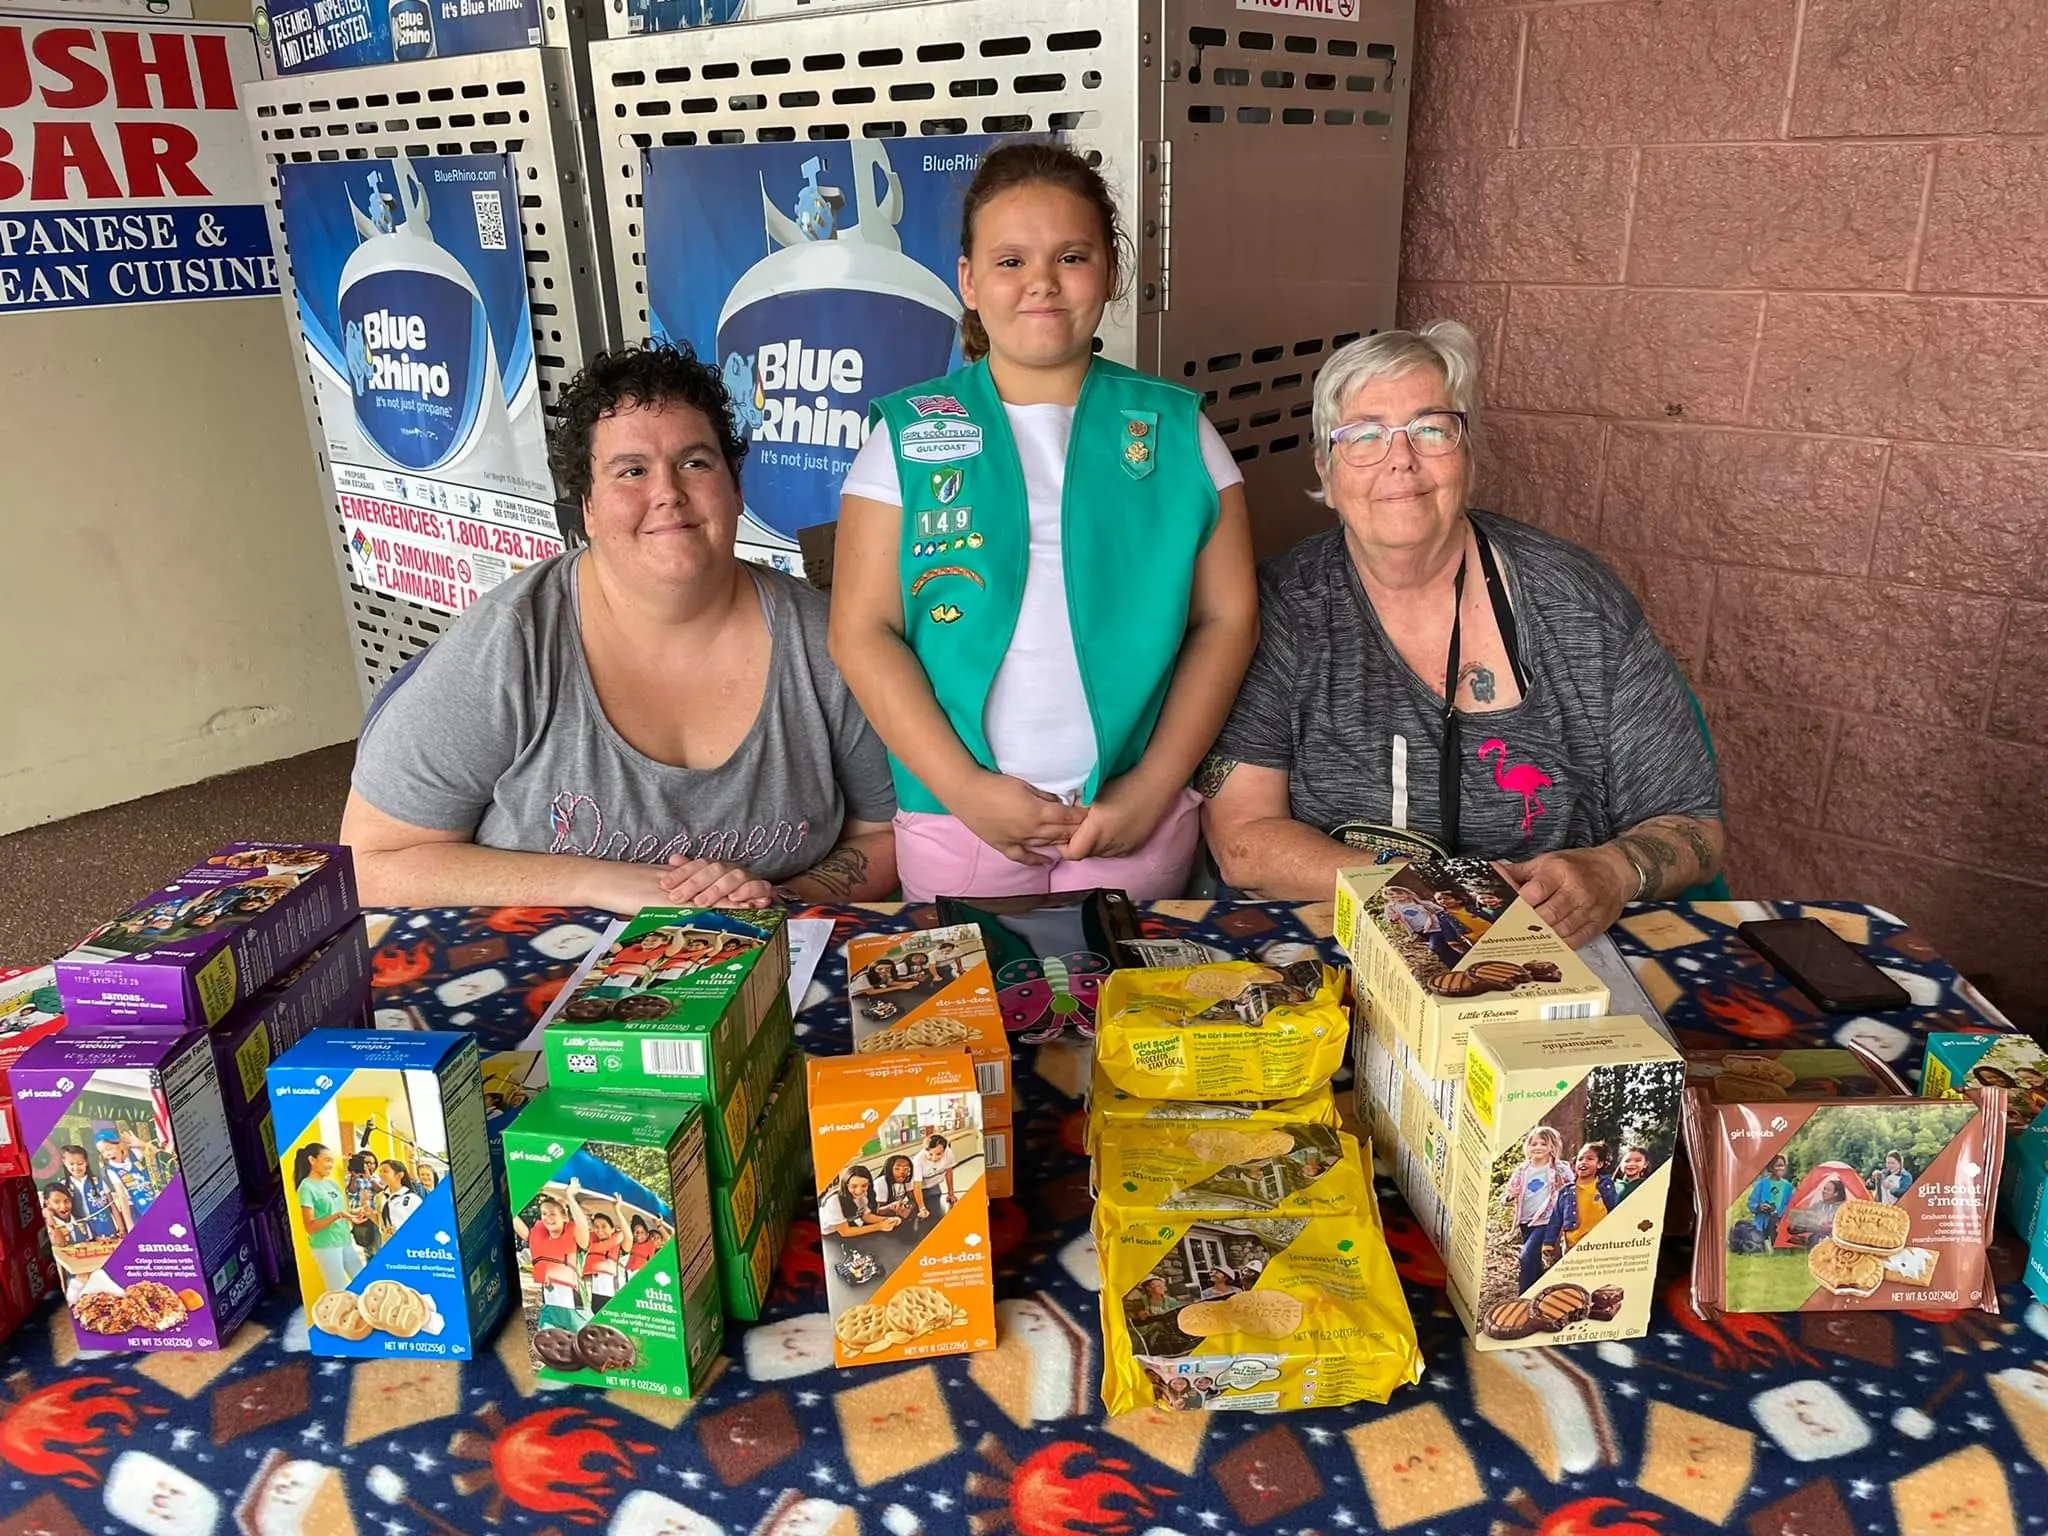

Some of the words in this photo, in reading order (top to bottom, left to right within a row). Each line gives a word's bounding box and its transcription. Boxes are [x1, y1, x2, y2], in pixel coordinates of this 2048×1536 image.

[442, 3, 458, 19] It's
[461, 0, 485, 15] Blue
[398, 12, 423, 28] Blue
[399, 28, 431, 46] Rhino
[281, 39, 301, 68] AND
[434, 168, 497, 184] BlueRhino.com
[195, 213, 227, 247] &
[109, 255, 280, 297] CUISINE
[364, 308, 427, 350] Blue
[758, 339, 863, 393] Blue
[369, 352, 450, 400] Rhino
[376, 395, 385, 408] It's
[387, 397, 400, 409] not
[400, 397, 415, 413] just
[752, 397, 870, 450] Rhin
[904, 431, 920, 439] GIRL
[760, 450, 778, 465] It's
[780, 453, 800, 467] not
[803, 453, 828, 472] just
[340, 495, 446, 540] EMERGENCIES:
[372, 537, 391, 563] NO
[394, 542, 456, 582] SMOKING
[377, 564, 458, 610] FLAMMABLE
[1481, 934, 1553, 945] adventurefuls
[1458, 1011, 1481, 1021] Little
[1133, 1041, 1151, 1050] Girl
[1153, 1036, 1180, 1048] Scout
[1139, 1045, 1176, 1057] Cookies
[18, 1089, 32, 1099] girl
[34, 1089, 61, 1099] scouts
[276, 1087, 291, 1097] girl
[292, 1087, 321, 1096] scouts
[1507, 1088, 1525, 1101] girl
[1526, 1088, 1558, 1099] scouts
[818, 1122, 834, 1136] girl
[836, 1120, 865, 1132] scouts
[1730, 1129, 1745, 1140] girl
[1746, 1129, 1774, 1138] scouts
[509, 1149, 523, 1161] girl
[524, 1152, 551, 1163] scouts
[1918, 1182, 1941, 1197] girl
[1943, 1184, 1981, 1195] scout
[138, 1243, 193, 1253] samoas.
[1121, 1235, 1134, 1244] girl
[1136, 1238, 1162, 1246] scouts
[1576, 1237, 1653, 1252] adventurefuls
[645, 1287, 673, 1303] thin
[1891, 1292, 1904, 1301] NET
[1905, 1292, 1916, 1301] WT
[635, 1299, 677, 1314] mints.
[128, 1337, 140, 1347] NET
[141, 1337, 152, 1347] WT
[1293, 1331, 1307, 1341] NET
[1552, 1335, 1564, 1344] NET
[1566, 1334, 1577, 1342] WT
[1588, 1331, 1599, 1340] OZ
[384, 1341, 396, 1351] NET
[398, 1342, 408, 1351] WT
[409, 1342, 415, 1351] 9
[904, 1347, 916, 1356] NET
[918, 1346, 929, 1354] WT
[606, 1376, 618, 1386] NET
[619, 1377, 629, 1387] WT
[631, 1378, 637, 1387] 9
